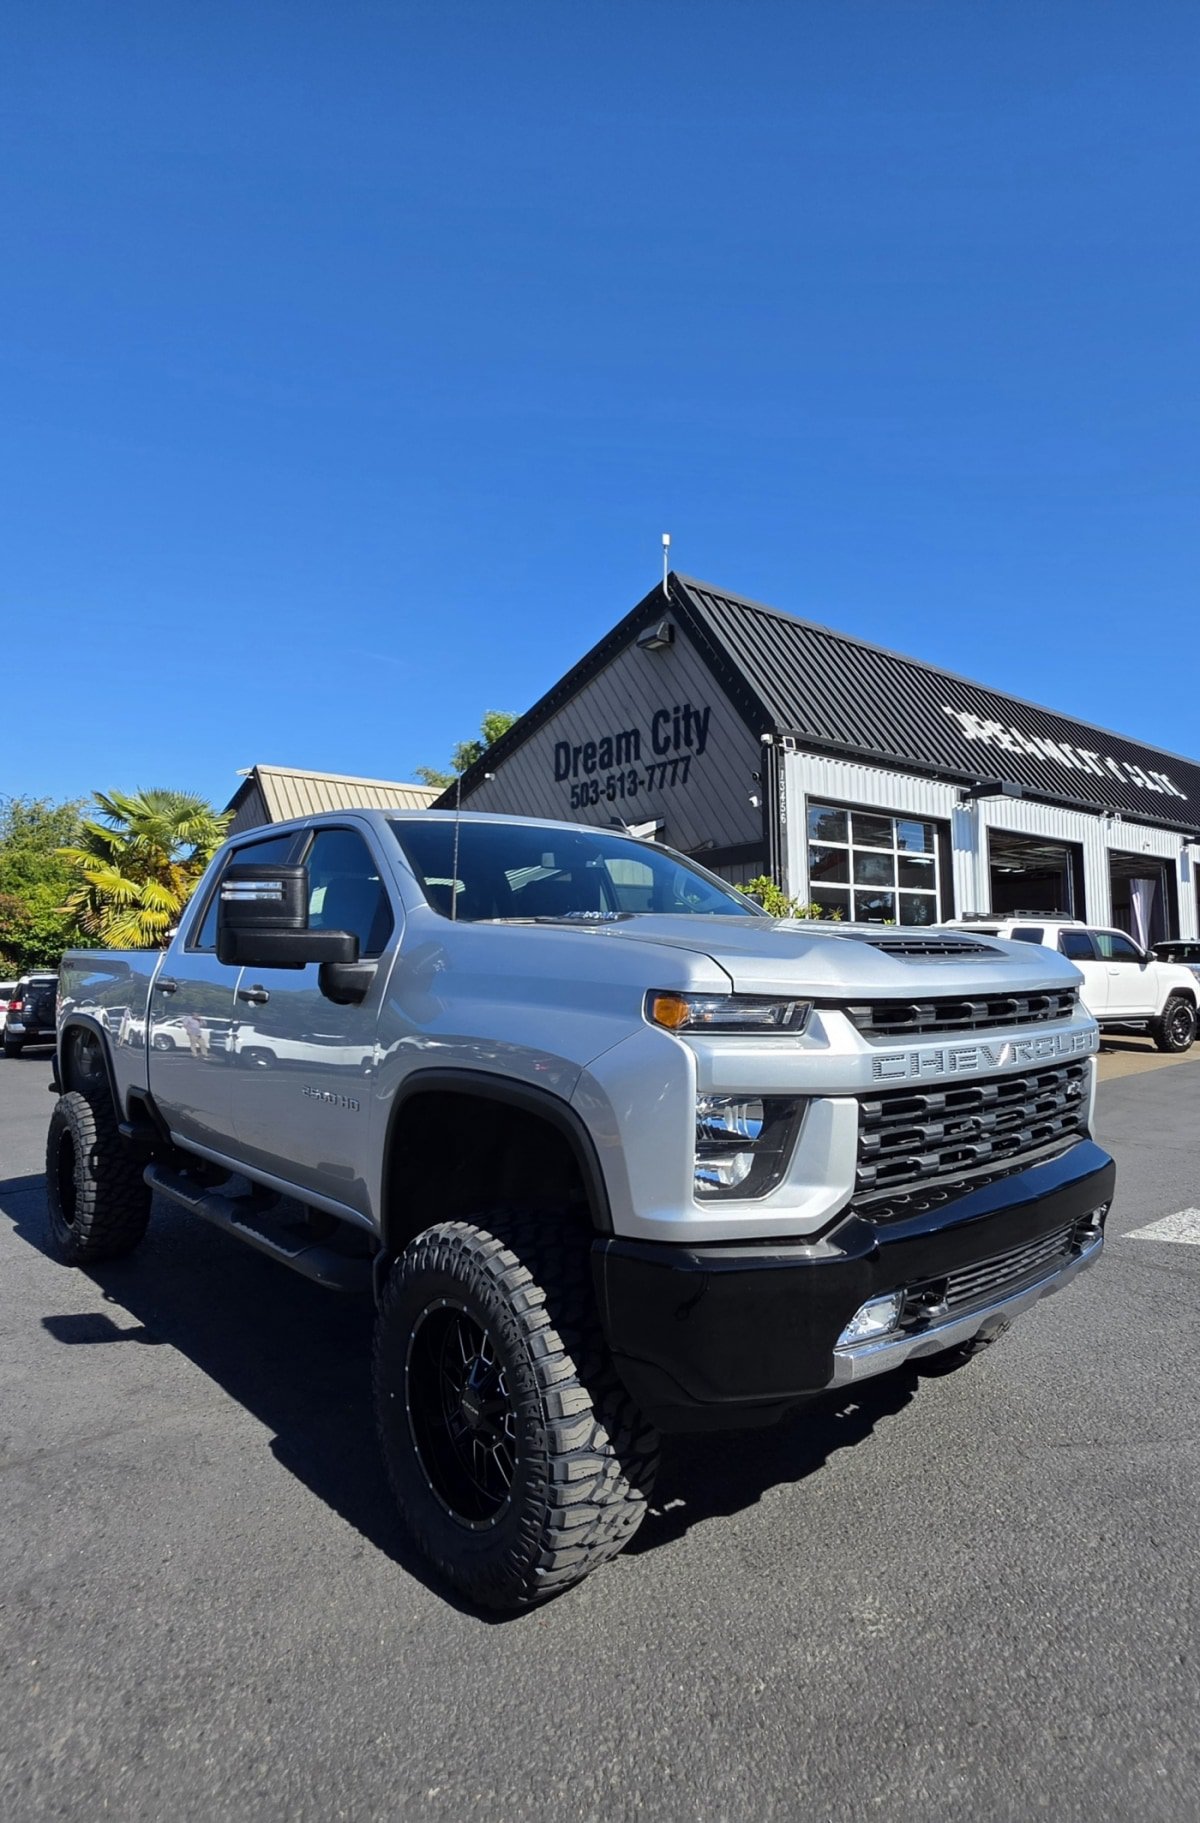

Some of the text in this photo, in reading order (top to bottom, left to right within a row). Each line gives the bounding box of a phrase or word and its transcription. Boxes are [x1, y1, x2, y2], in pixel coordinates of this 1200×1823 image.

[554, 703, 711, 782] Dream City
[570, 755, 692, 810] 503-513-7777
[872, 1029, 1098, 1082] CHEVROLET
